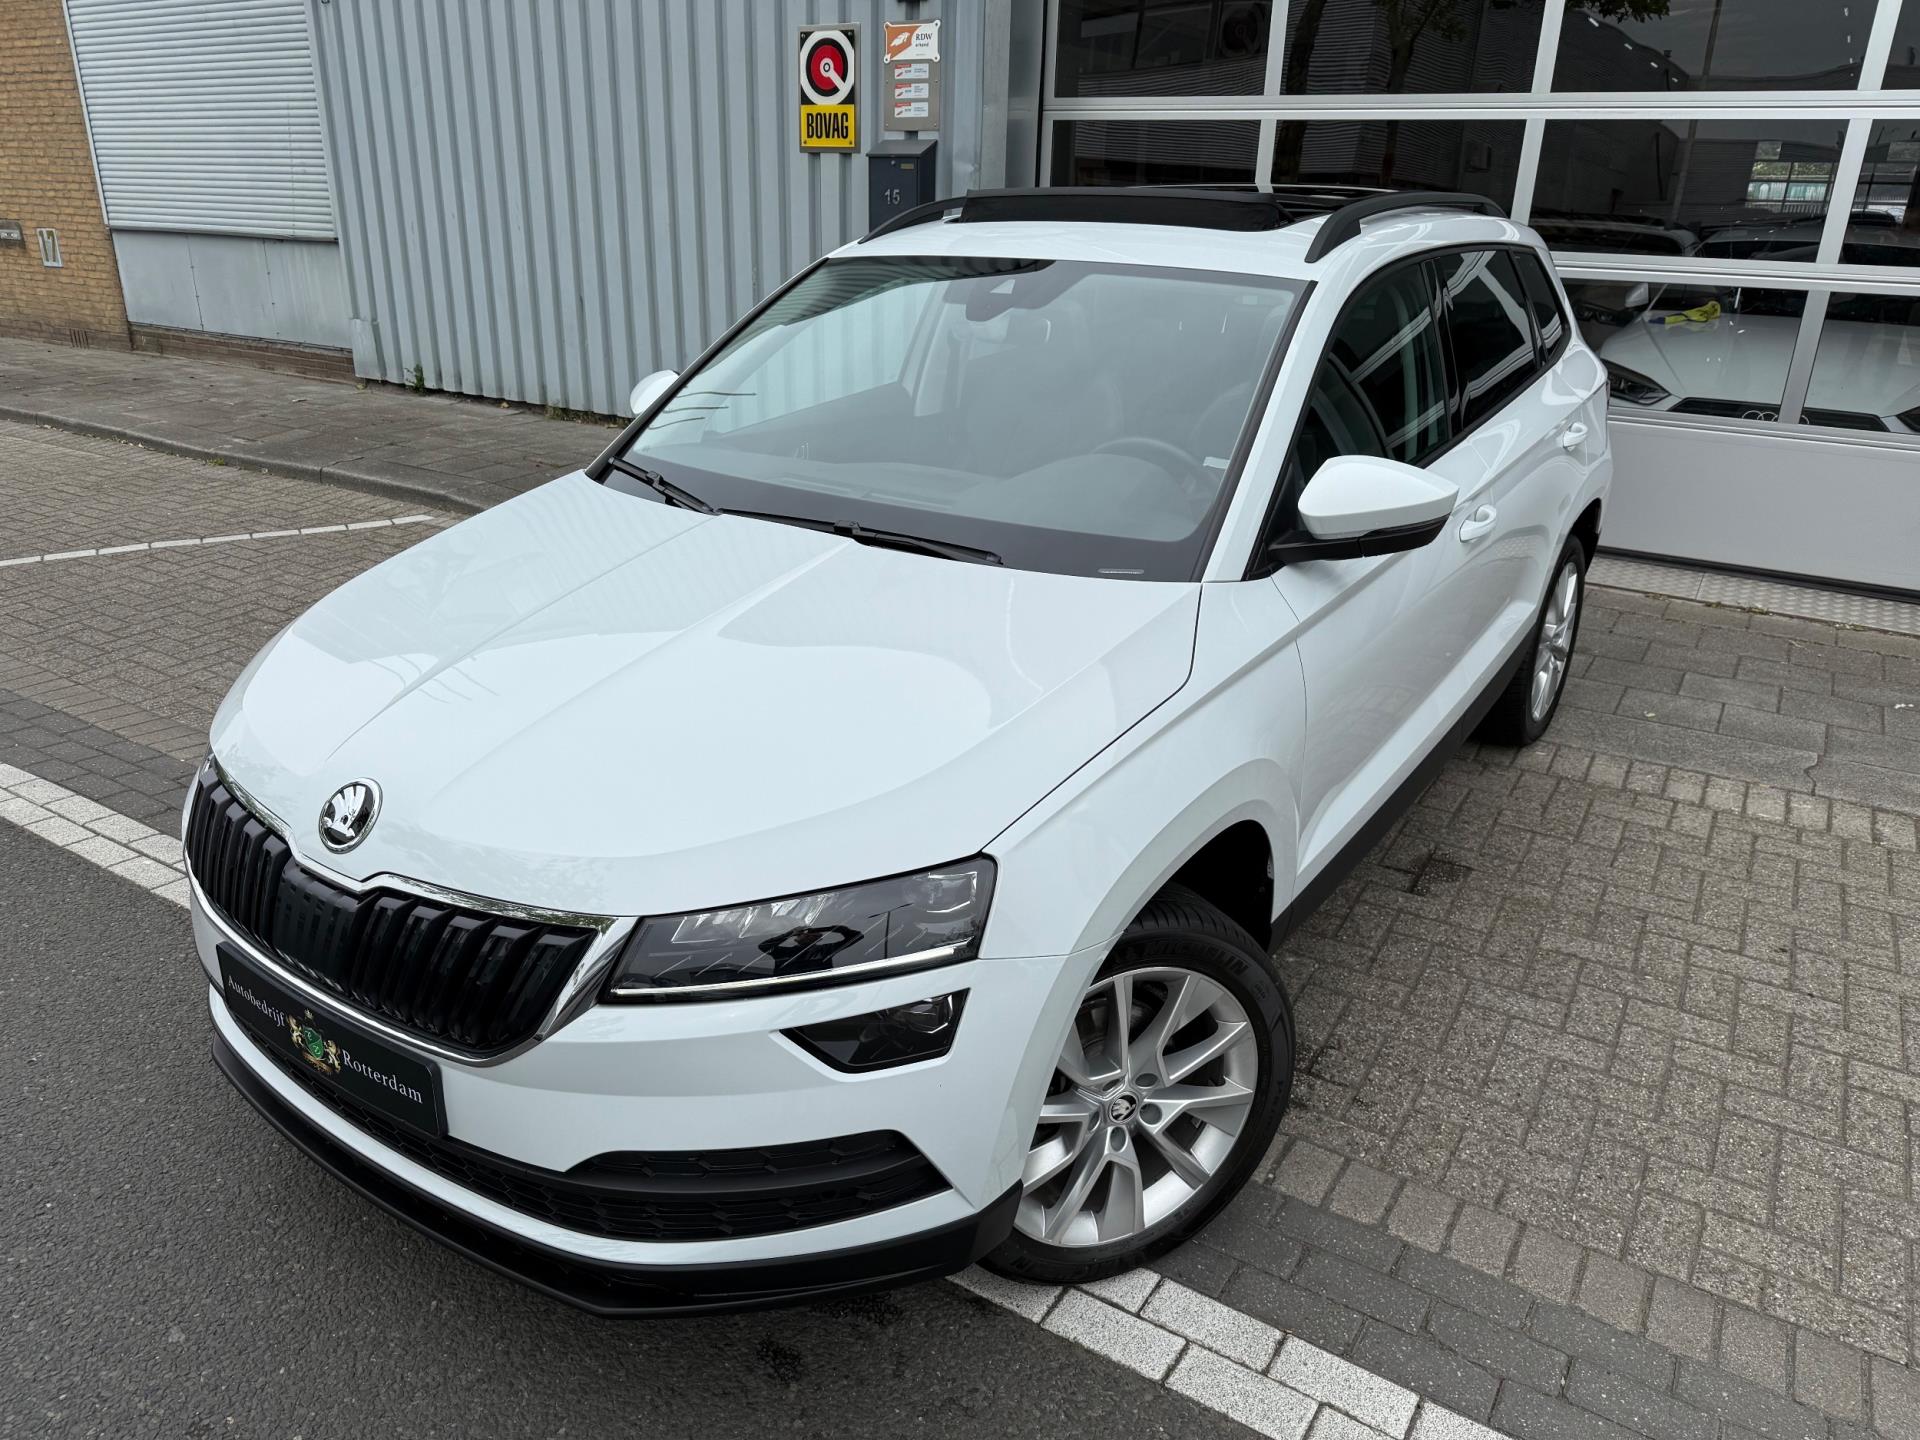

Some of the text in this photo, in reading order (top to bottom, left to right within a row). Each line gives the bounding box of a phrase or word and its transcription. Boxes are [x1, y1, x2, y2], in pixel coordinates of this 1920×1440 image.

[915, 33, 933, 41] RDW
[806, 112, 849, 140] BOVAG
[884, 188, 900, 205] 15
[38, 230, 56, 263] 17
[227, 975, 424, 1104] Autobedrijf Rotterdam
